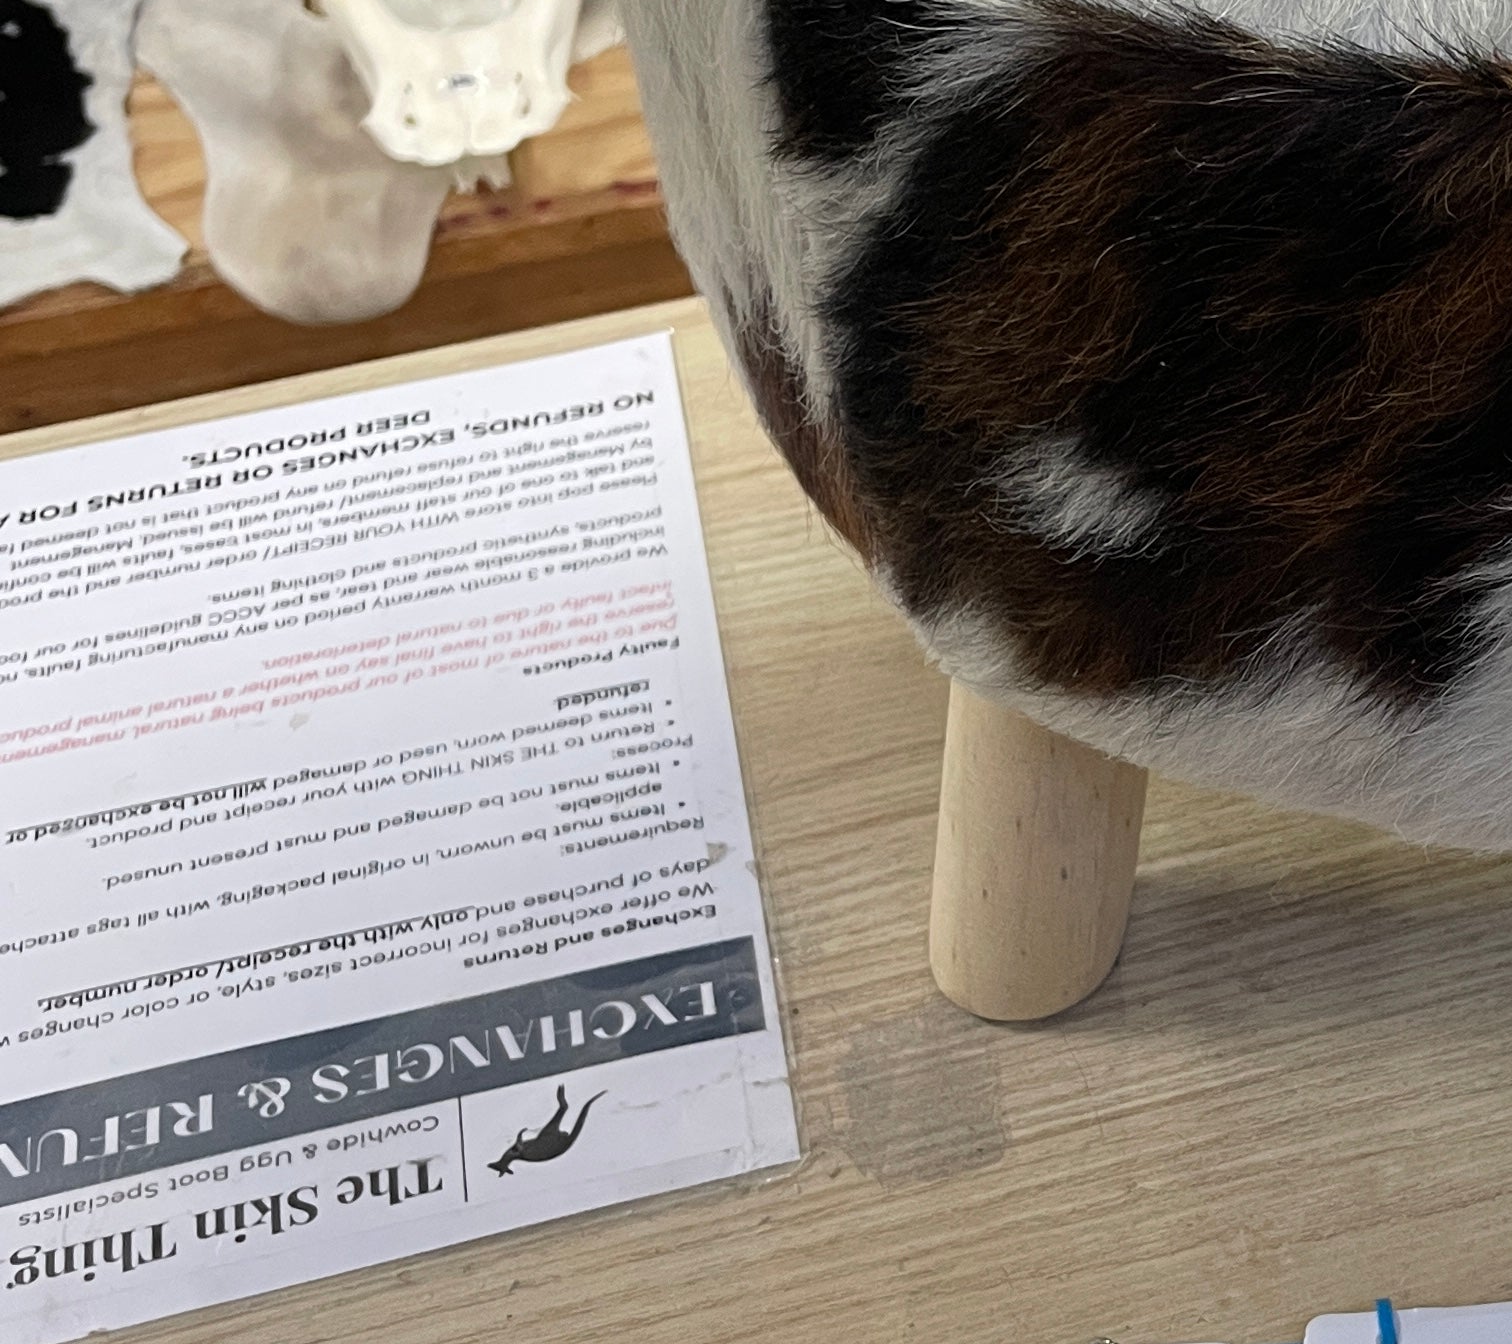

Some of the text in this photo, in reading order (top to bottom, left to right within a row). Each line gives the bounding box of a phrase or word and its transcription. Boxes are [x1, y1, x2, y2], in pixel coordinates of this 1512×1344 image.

[182, 409, 430, 468] DEER PRODUCTS.
[18, 390, 654, 524] NO REFUNDS, EXCHANGES OR RETURNS FOR
[522, 635, 680, 676] Faulty Products
[598, 701, 653, 721] Items
[511, 713, 593, 741] deemed
[590, 720, 655, 743] Return
[521, 741, 556, 761] THE
[563, 735, 584, 748] to
[372, 754, 393, 768] or
[398, 743, 447, 765] used
[469, 749, 514, 771] SKIN
[272, 759, 366, 791] damaged
[401, 760, 463, 785] THING
[604, 761, 660, 781] Items
[232, 781, 266, 801] will
[301, 781, 347, 803] your
[352, 774, 396, 793] with
[510, 785, 543, 803] not
[549, 774, 599, 795] must
[158, 797, 185, 811] be
[191, 789, 227, 806] not
[224, 794, 296, 821] receipt
[477, 794, 504, 808] be
[33, 800, 153, 842] exchanged
[178, 812, 217, 832] and
[377, 801, 472, 833] damaged
[609, 802, 665, 823] Items
[332, 821, 371, 842] and
[520, 827, 547, 842] be
[552, 815, 603, 836] must
[5, 831, 28, 844] or
[276, 830, 326, 852] must
[189, 839, 268, 871] present
[411, 852, 429, 865] in
[331, 857, 406, 885] original
[658, 856, 711, 878] days
[522, 872, 624, 907] purchase
[631, 870, 652, 887] of
[619, 889, 671, 911] offer
[676, 881, 714, 899] We
[137, 909, 159, 927] all
[165, 899, 210, 919] with
[419, 906, 468, 931] only
[474, 899, 515, 922] and
[495, 902, 613, 938] exchanges
[86, 916, 130, 935] tags
[363, 922, 413, 944] with
[463, 903, 716, 968] Exchanges and Returns
[317, 934, 356, 951] the
[457, 929, 488, 946] for
[214, 940, 311, 979] receipt/
[349, 937, 451, 971] incorrect
[142, 966, 208, 990] order
[120, 996, 179, 1019] color
[186, 990, 210, 1005] or
[17, 1010, 114, 1043] changes
[312, 982, 716, 1103] EXCHANGES
[237, 1077, 292, 1118] &
[18, 1115, 439, 1227] Cowhide & Ugg Boot Specialists
[5, 1157, 443, 1289] The Skin Thing
